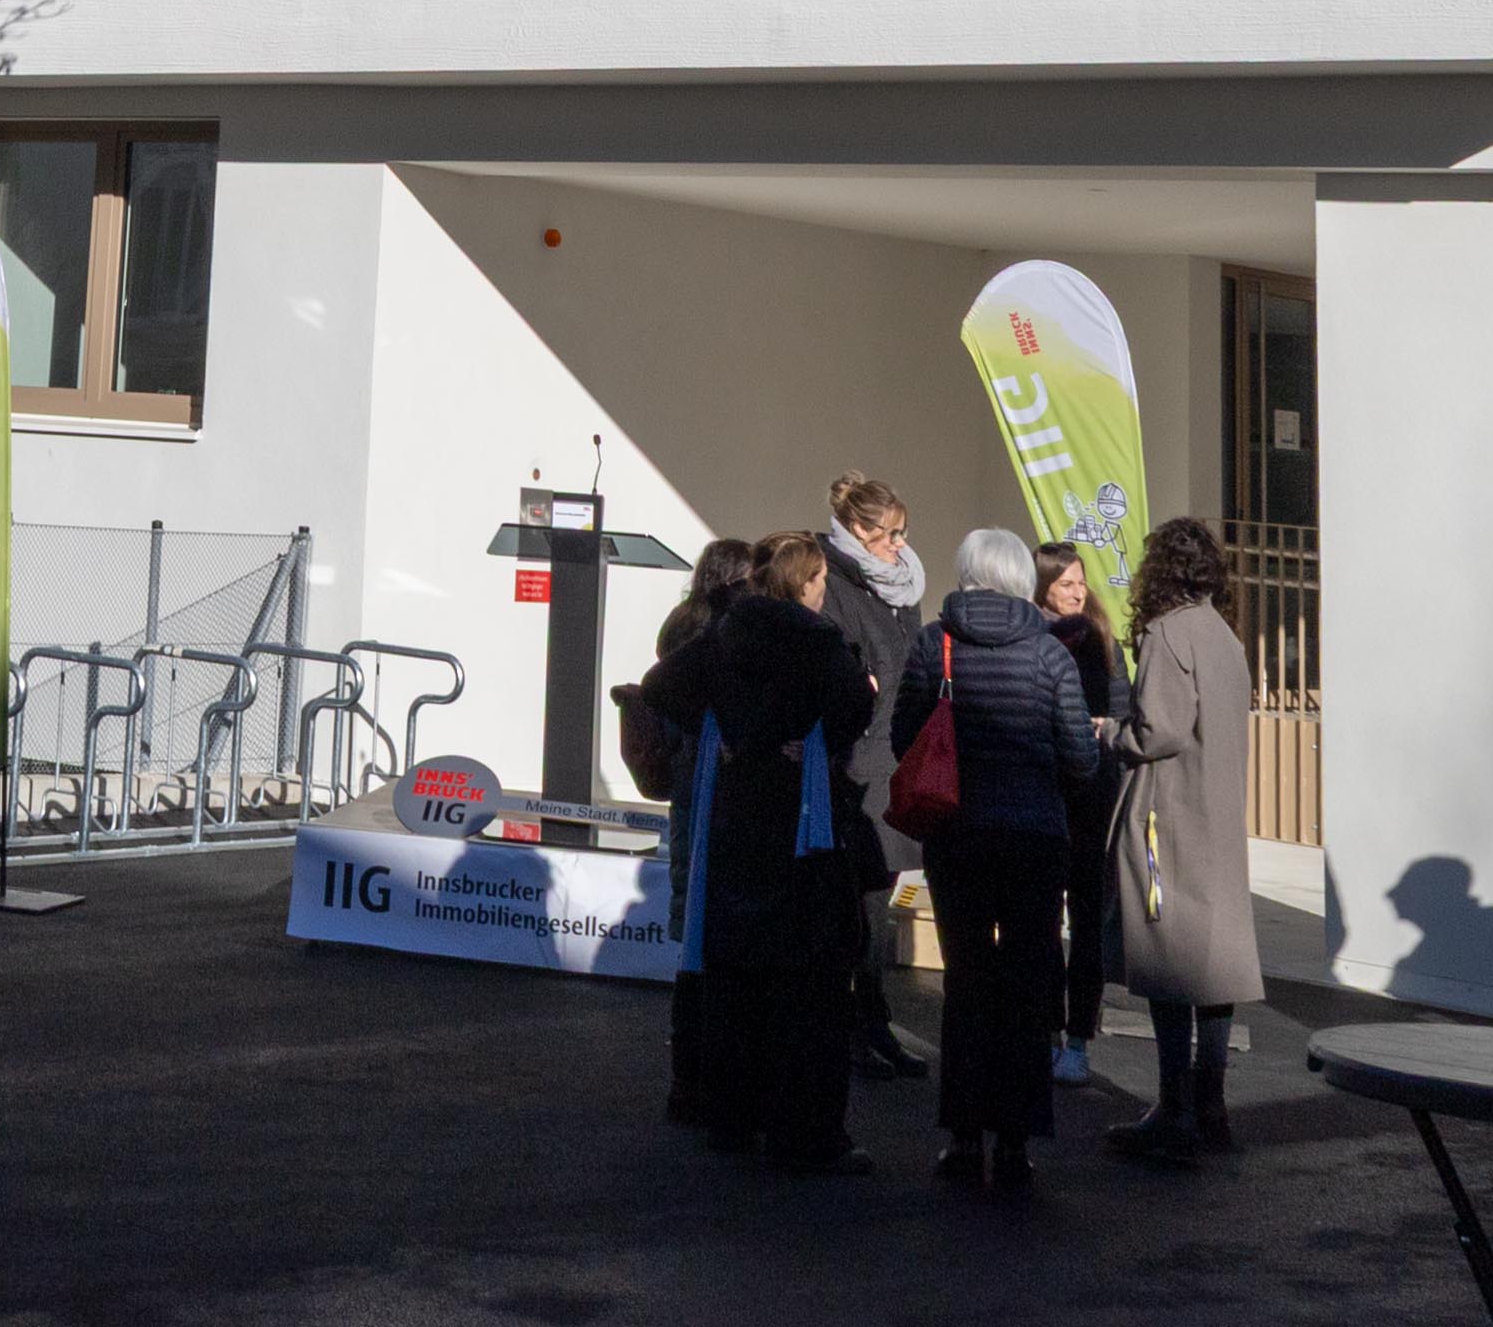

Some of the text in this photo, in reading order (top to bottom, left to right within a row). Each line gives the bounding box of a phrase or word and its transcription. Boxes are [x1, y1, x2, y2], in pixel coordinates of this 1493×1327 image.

[412, 782, 486, 803] BRUCK
[422, 800, 466, 825] IIG
[525, 800, 571, 816] Meine
[322, 860, 544, 914] IIG Innsbrucker
[415, 898, 666, 945] Immobiliengesellschaft
